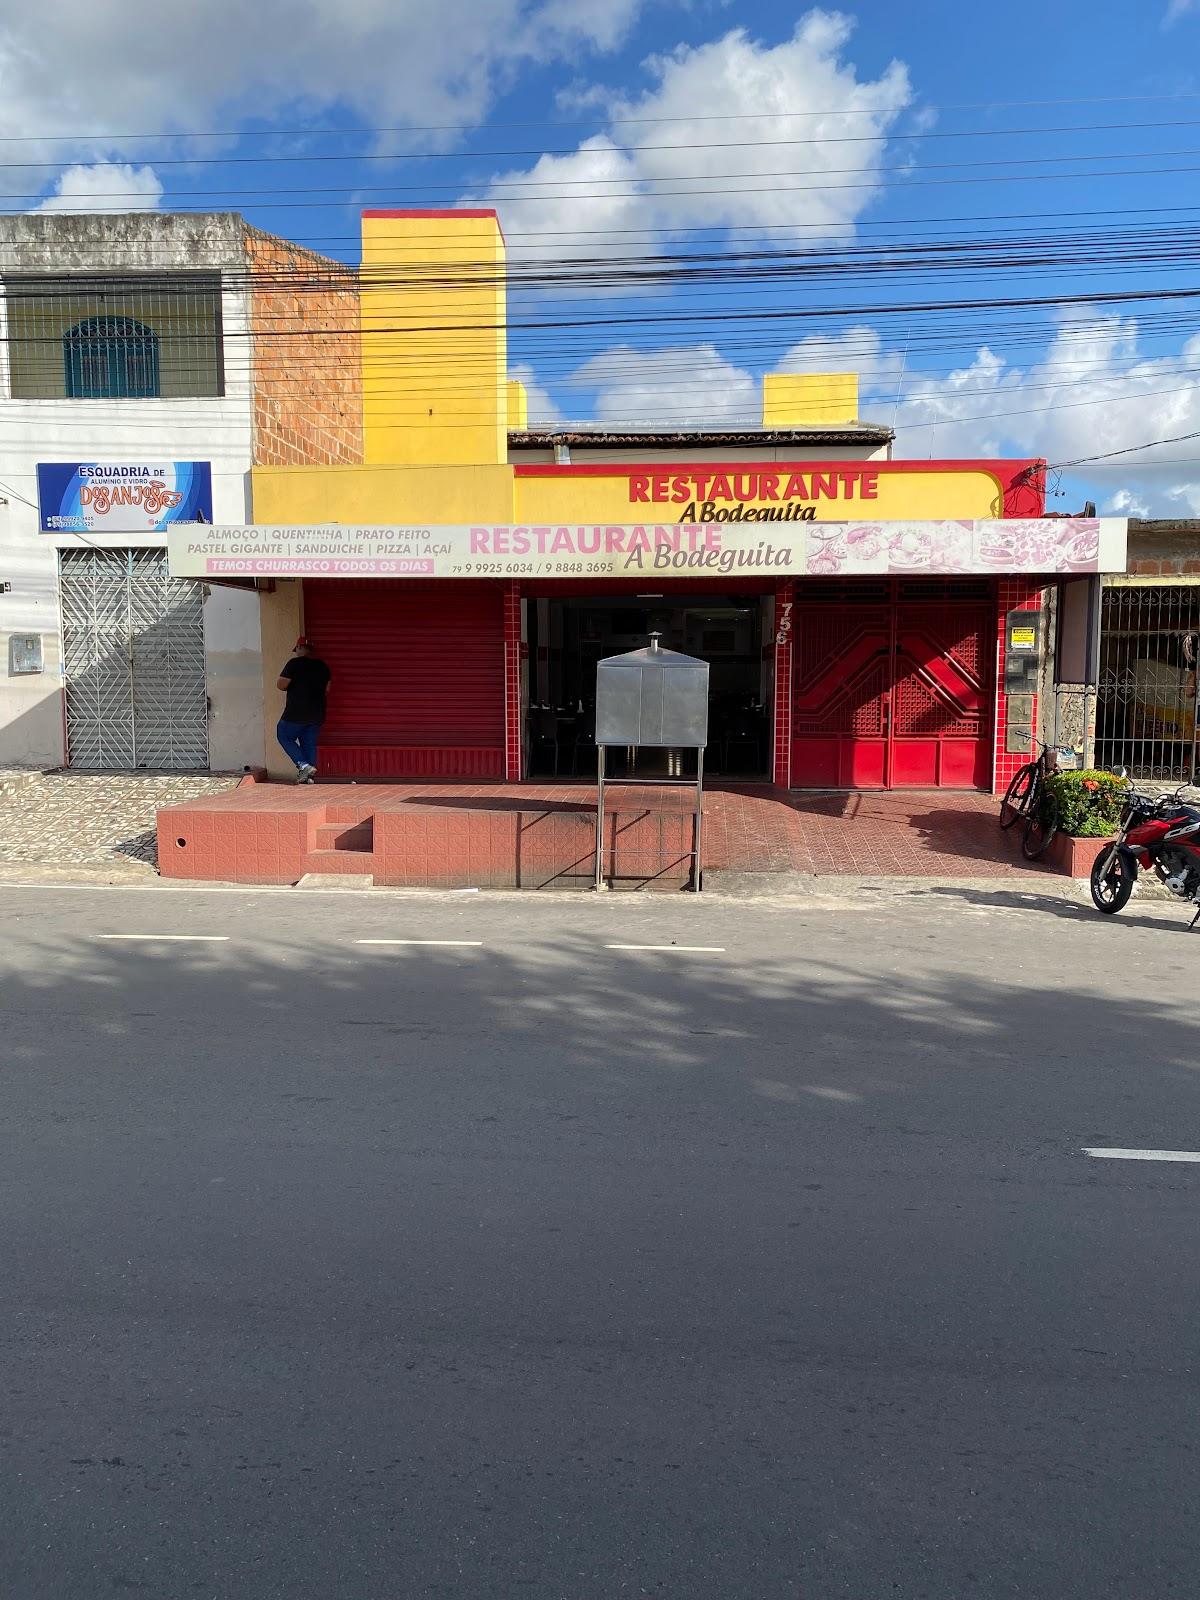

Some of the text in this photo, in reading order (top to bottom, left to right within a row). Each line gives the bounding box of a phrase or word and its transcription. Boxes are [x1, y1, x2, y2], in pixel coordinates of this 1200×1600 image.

[79, 467, 150, 477] ESQUADRIA
[629, 472, 879, 503] RESTAURANTE
[679, 502, 696, 523] A
[207, 529, 259, 541] ALMOÇO
[271, 529, 343, 540] QUENTINHA
[355, 529, 395, 540] PRATO
[398, 529, 431, 540] FEITO
[470, 525, 722, 555] RESTAURANTE
[187, 543, 227, 553] PASTEL
[230, 543, 283, 554] GIGANTE
[295, 544, 364, 554] SANDUICHE
[376, 544, 411, 554] PIZZA
[423, 541, 452, 556] AÇAÍ
[623, 542, 793, 573] A Bodeguita
[212, 560, 429, 571] TEMOS CHURRASCO TODOS OS DIAS
[465, 563, 472, 573] 9
[475, 563, 502, 573] 9925
[506, 563, 533, 573] 6034
[545, 563, 552, 572] 9
[555, 563, 583, 572] 8848
[586, 562, 613, 572] 3695
[776, 603, 793, 645] 756
